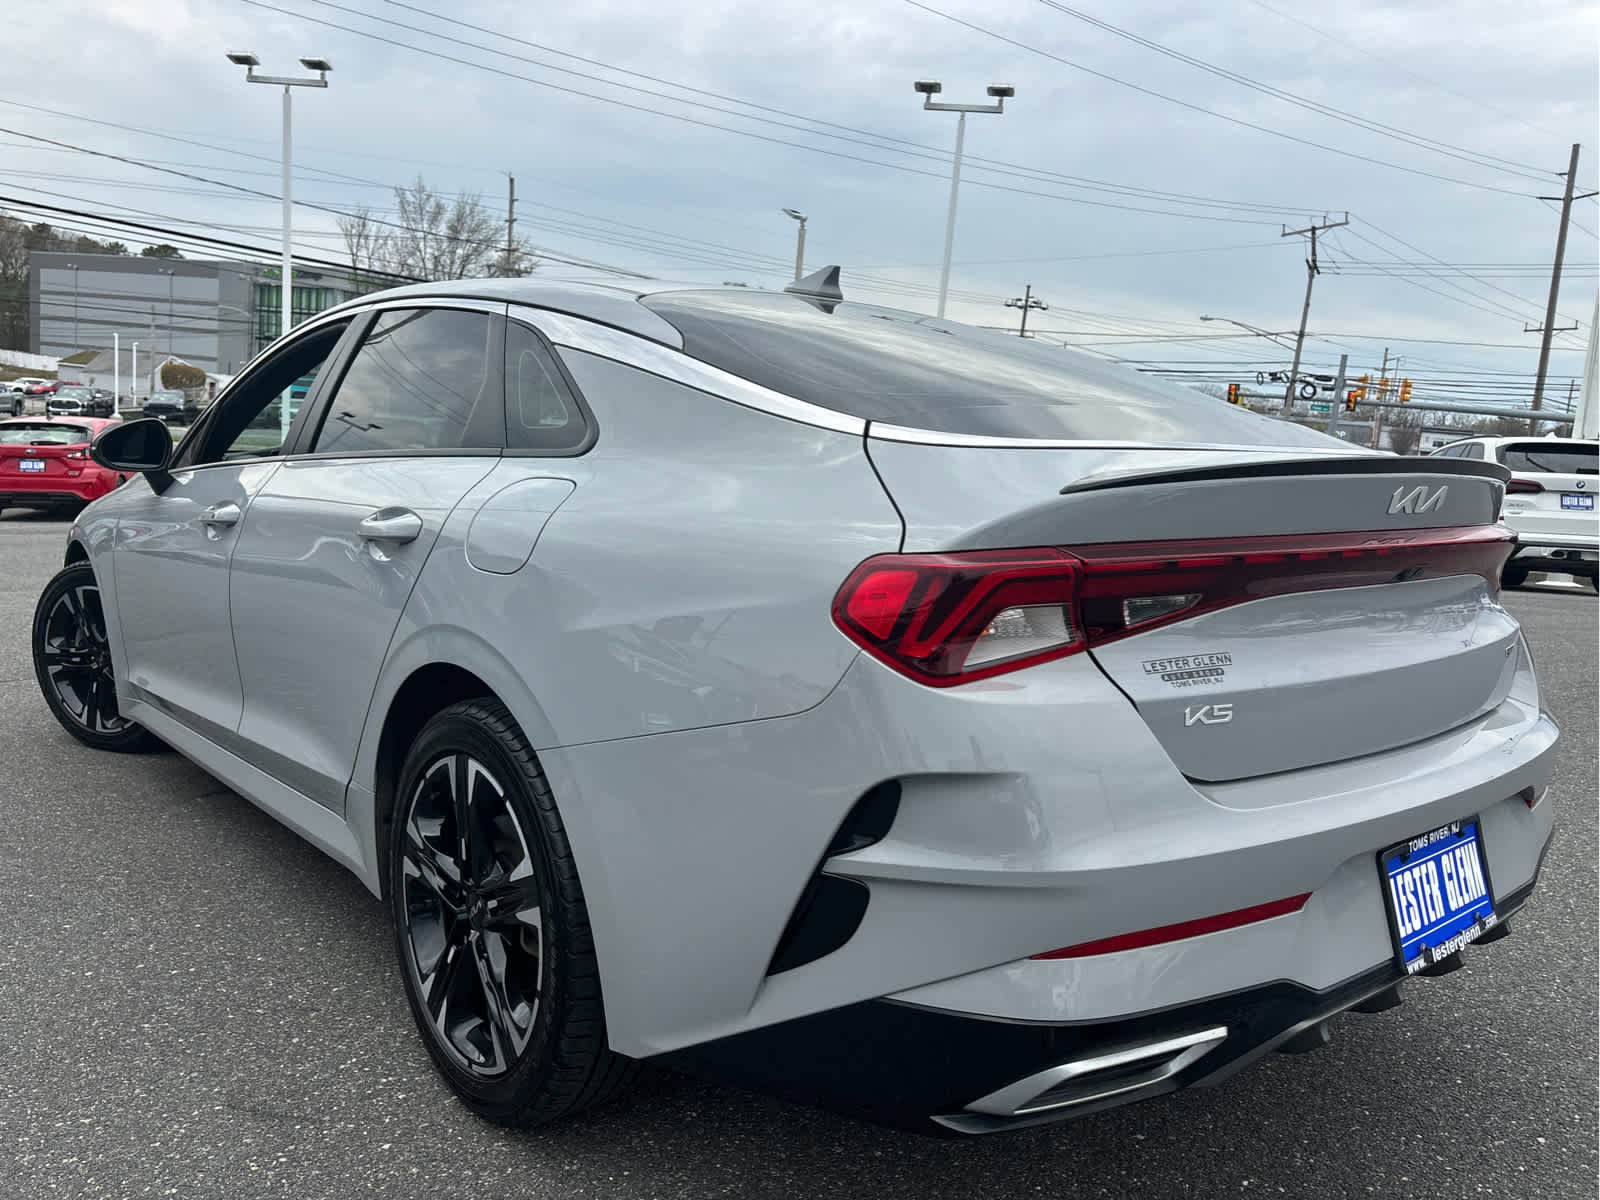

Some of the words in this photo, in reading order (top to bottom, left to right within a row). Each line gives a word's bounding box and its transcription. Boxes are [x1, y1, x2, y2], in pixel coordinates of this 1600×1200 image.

[1387, 485, 1448, 514] KIA
[1143, 659, 1190, 673] LESTER
[1193, 655, 1232, 667] GLENN
[1171, 679, 1192, 688] TOMS
[1184, 704, 1233, 727] K5
[1409, 835, 1429, 853] TOMS
[1451, 820, 1460, 834] NJ
[1389, 860, 1445, 938] LESTER
[1441, 841, 1486, 912] GLENN
